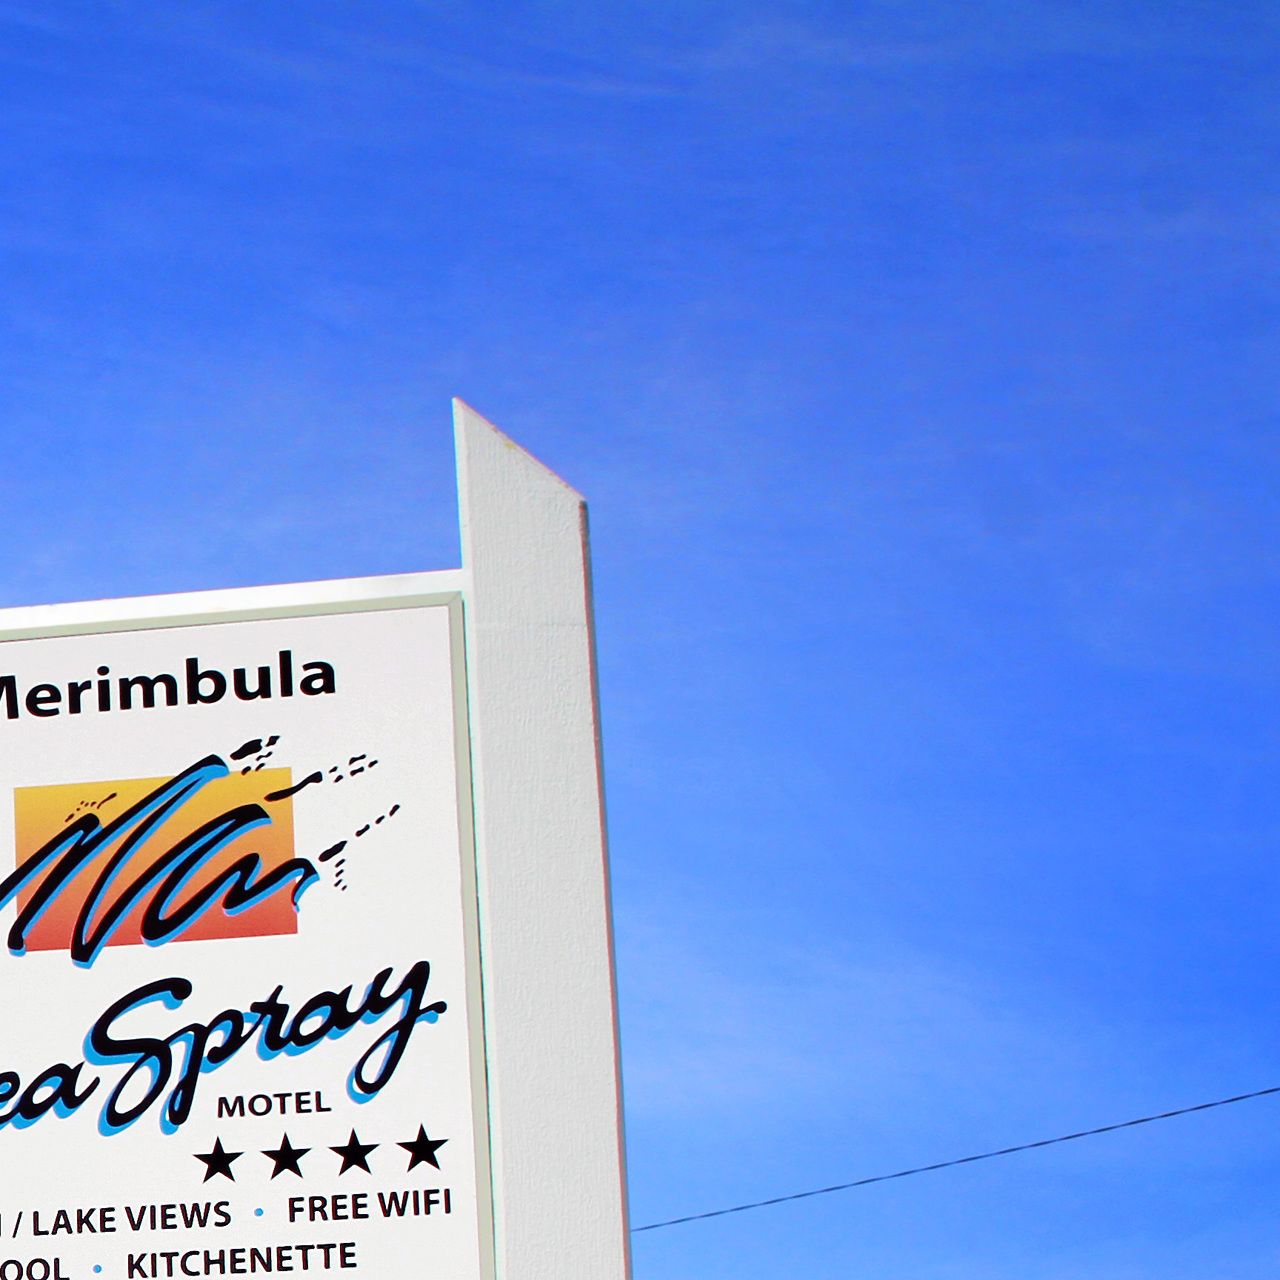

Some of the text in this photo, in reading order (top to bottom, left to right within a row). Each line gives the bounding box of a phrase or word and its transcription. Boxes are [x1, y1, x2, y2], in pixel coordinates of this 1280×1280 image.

[217, 1090, 332, 1119] MOTEL
[32, 1206, 117, 1237] LAKE
[124, 1200, 232, 1231] VIEWS
[288, 1192, 370, 1223] FREE
[377, 1188, 451, 1218] WIFI
[127, 1241, 357, 1280] KITCHENETTE
